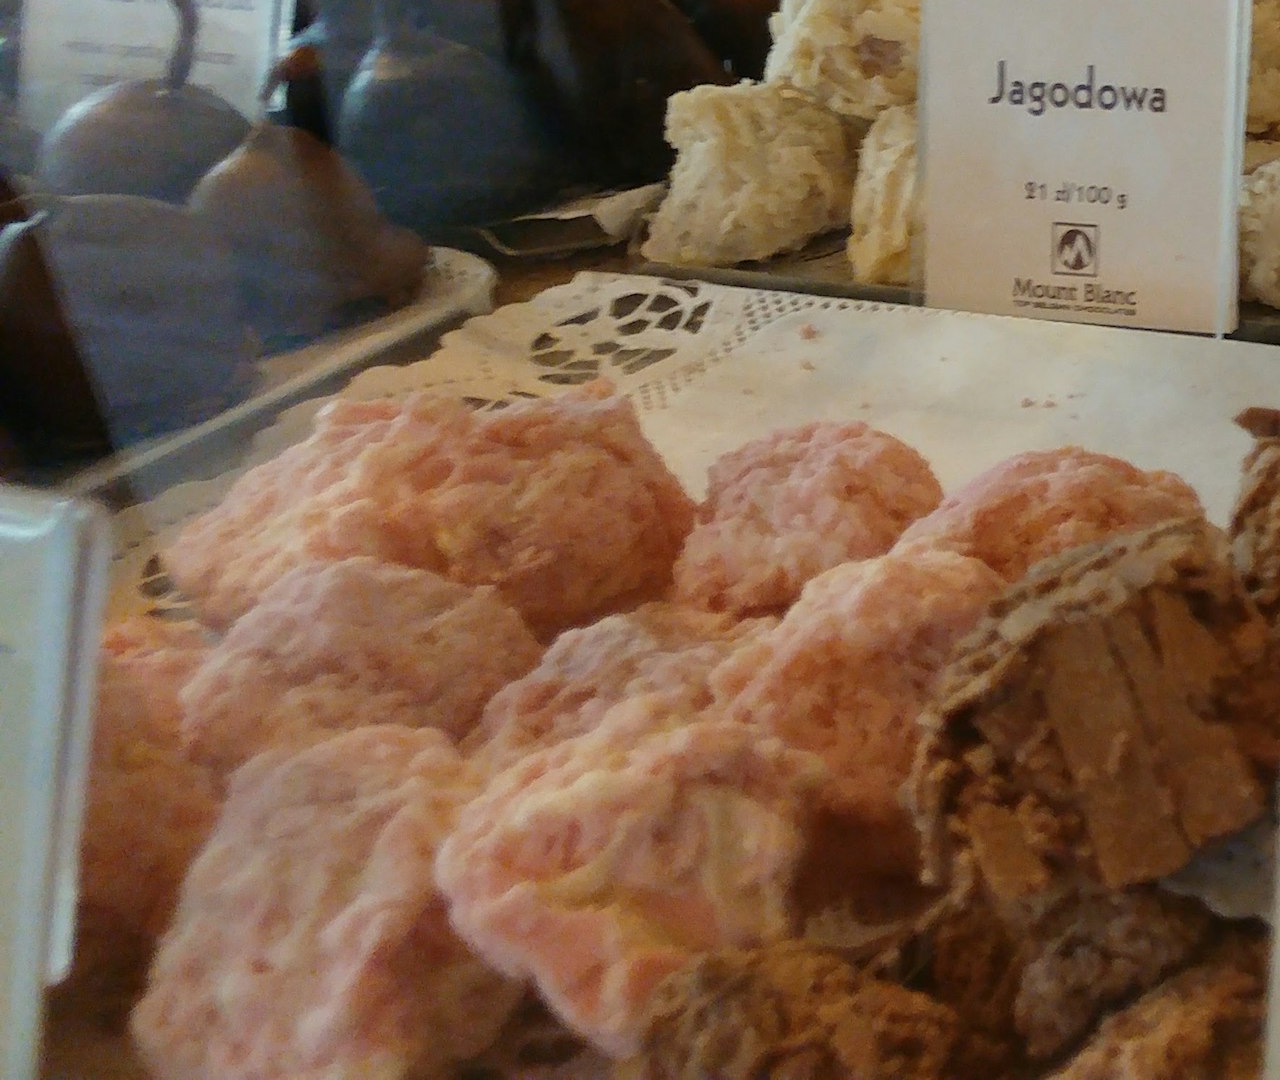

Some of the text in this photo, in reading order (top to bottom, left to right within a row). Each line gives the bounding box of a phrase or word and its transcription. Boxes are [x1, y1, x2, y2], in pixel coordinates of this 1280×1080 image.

[987, 60, 1168, 117] Jagodowa
[1117, 193, 1128, 209] g
[1012, 277, 1137, 306] Mount Blanc
